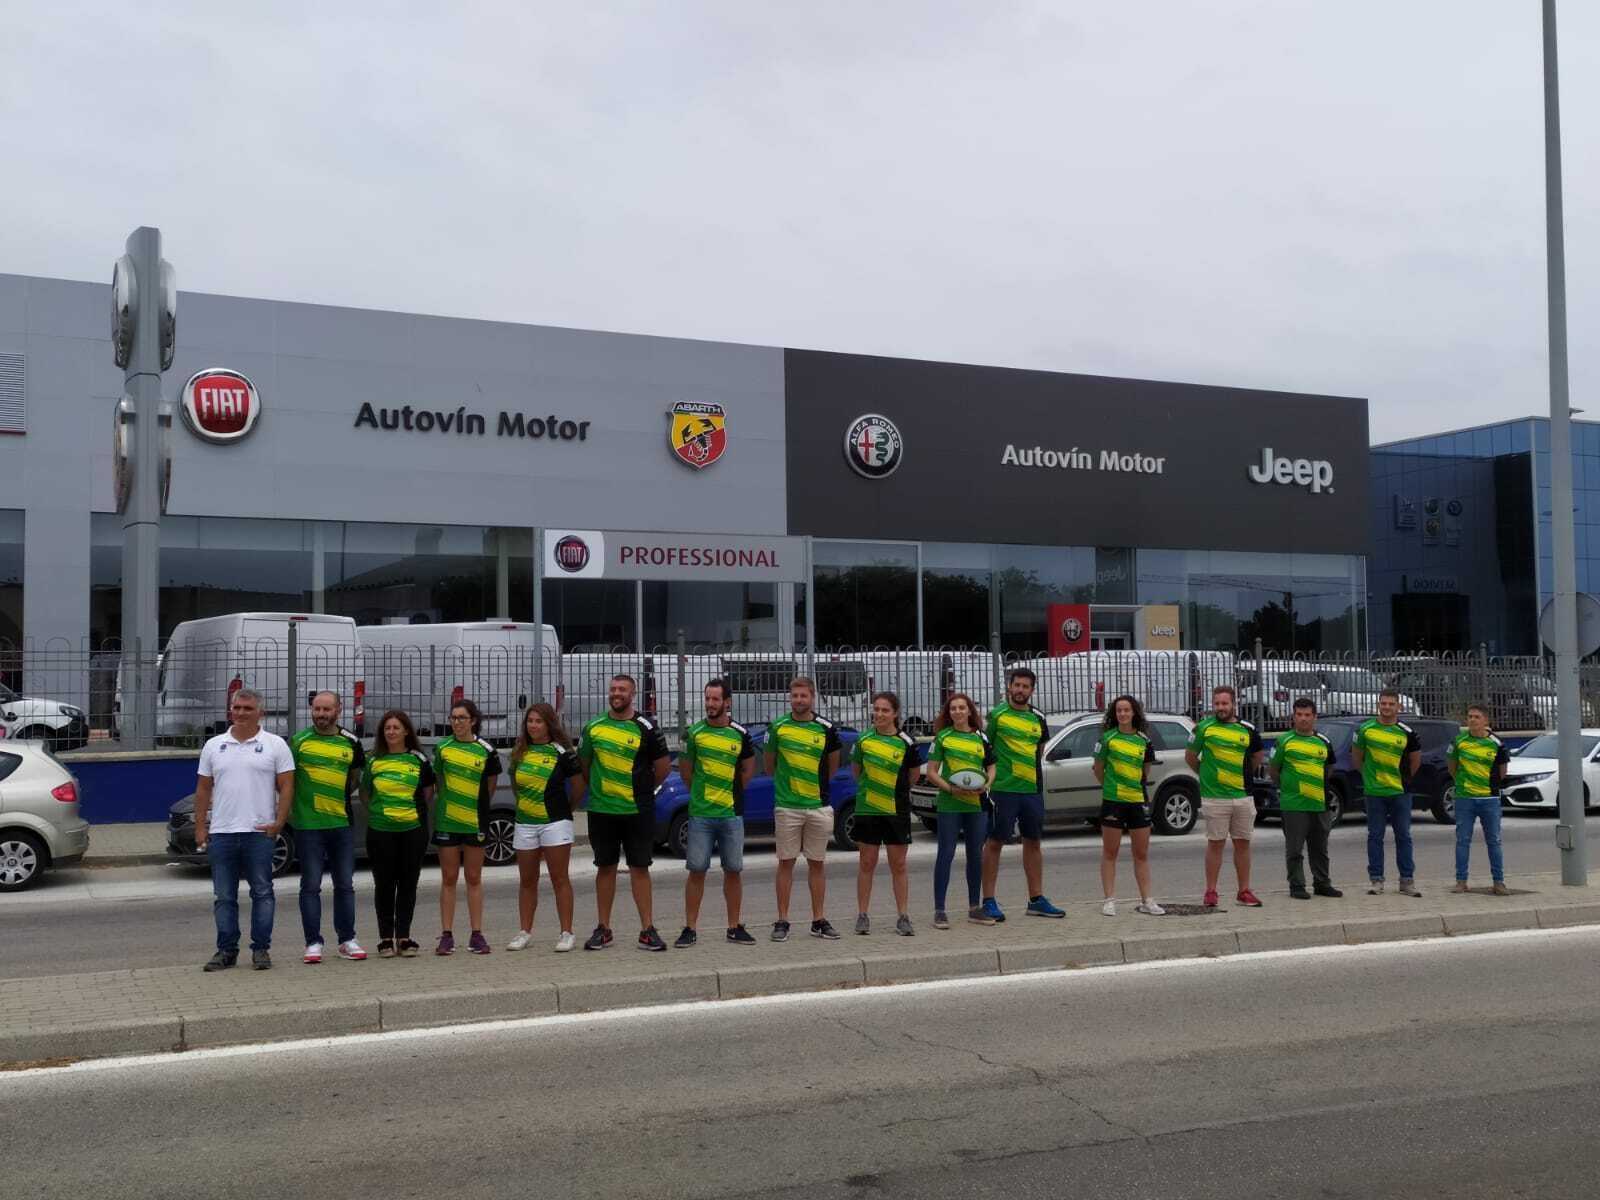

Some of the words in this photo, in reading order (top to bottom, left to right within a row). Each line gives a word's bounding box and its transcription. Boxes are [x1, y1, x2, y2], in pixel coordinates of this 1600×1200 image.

[200, 387, 245, 419] FIAT
[676, 403, 721, 414] ABARTH
[354, 401, 486, 436] Autovín
[497, 410, 591, 442] Motor
[850, 420, 869, 446] ALFA
[871, 418, 900, 449] ROMEO
[1001, 444, 1093, 471] Autovín
[1099, 450, 1167, 475] Motor
[562, 546, 583, 563] FIAT
[620, 545, 781, 568] PROFESSIONAL
[1151, 625, 1176, 637] Jeep
